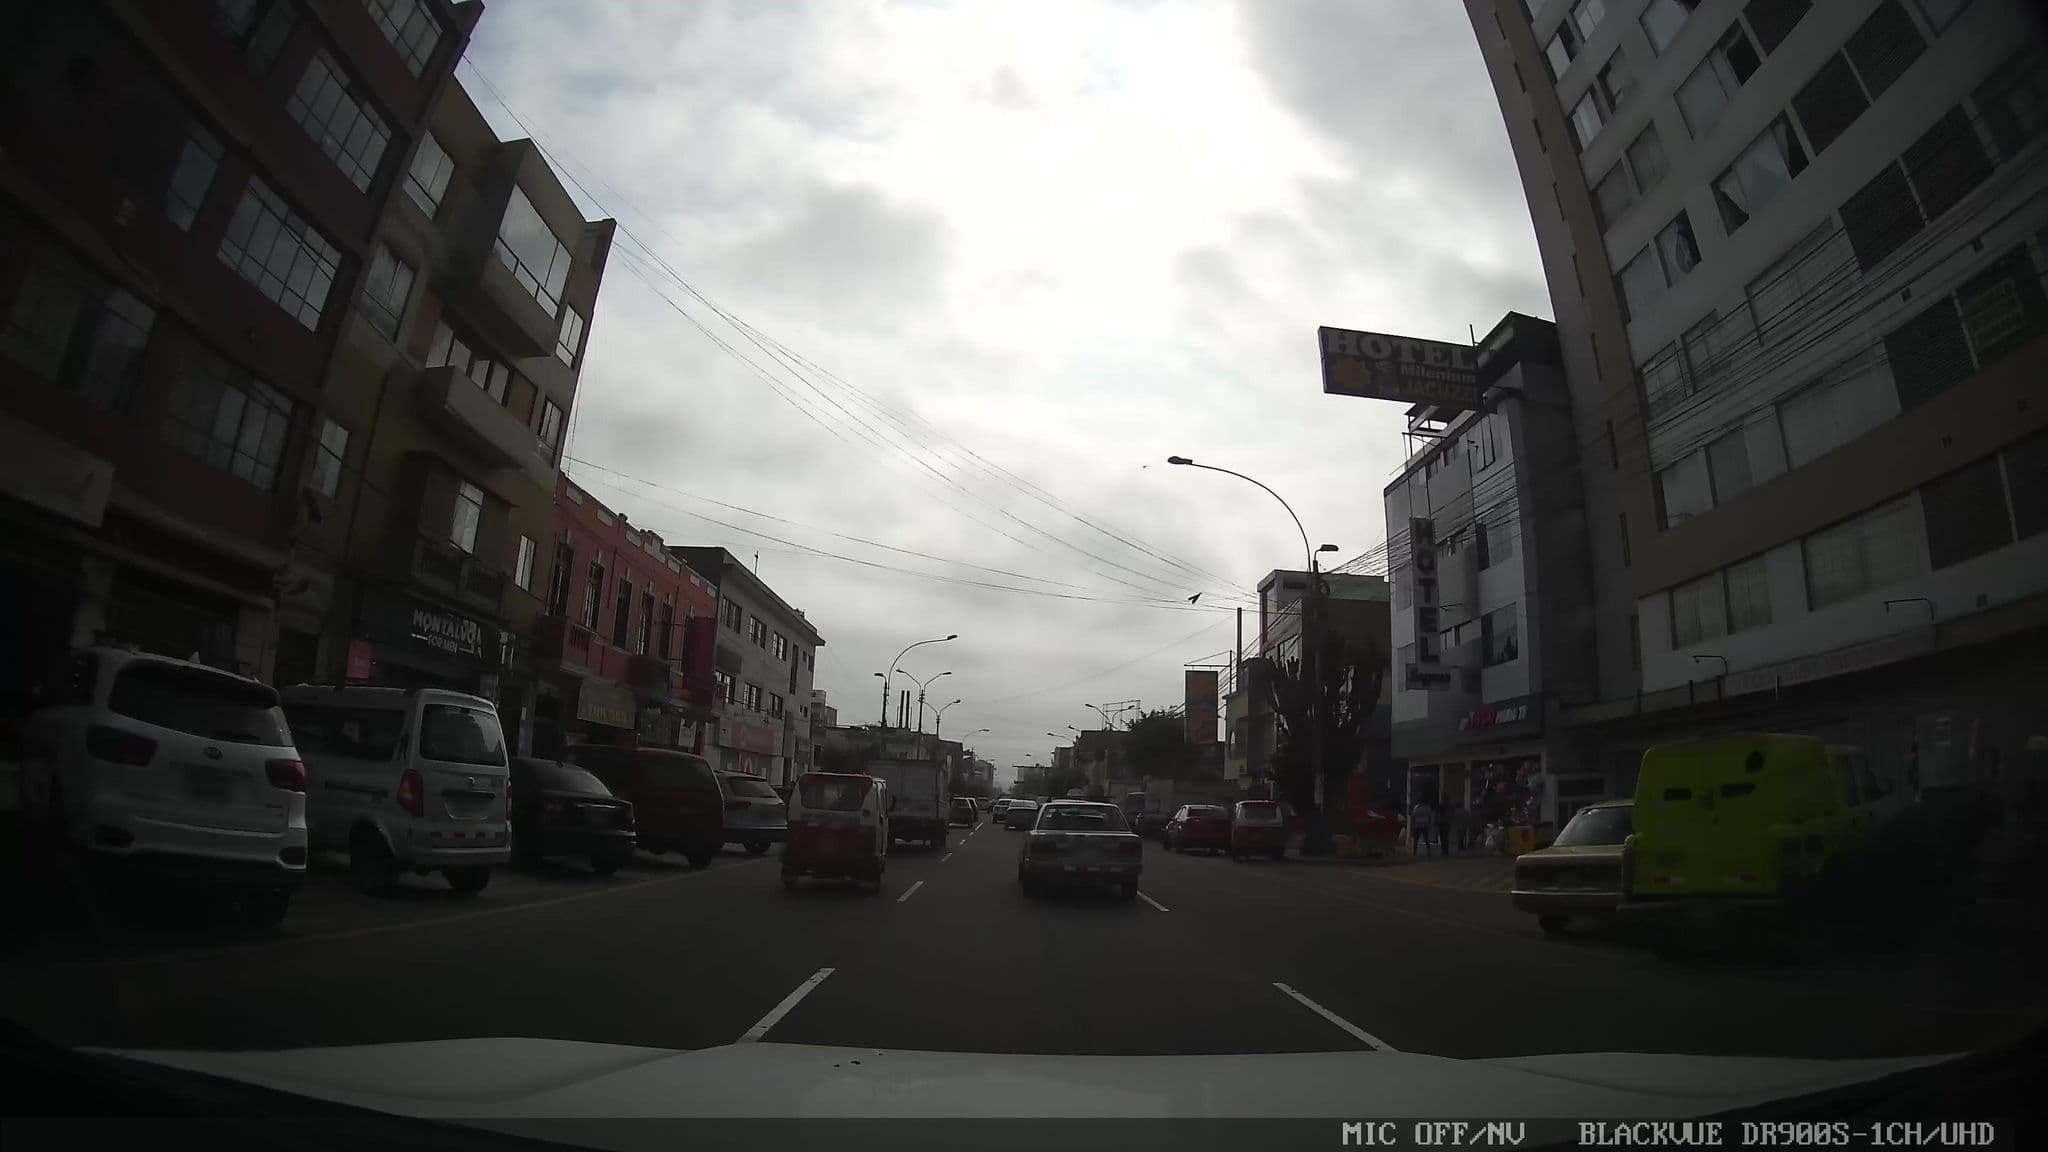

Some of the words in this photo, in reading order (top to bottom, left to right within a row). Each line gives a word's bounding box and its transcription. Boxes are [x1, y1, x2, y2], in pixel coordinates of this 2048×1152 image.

[1326, 331, 1477, 370] HOTEL
[1399, 362, 1477, 384] Milenium
[1414, 519, 1440, 663] HOTEL
[427, 634, 442, 648] FOR
[443, 640, 458, 654] MEN
